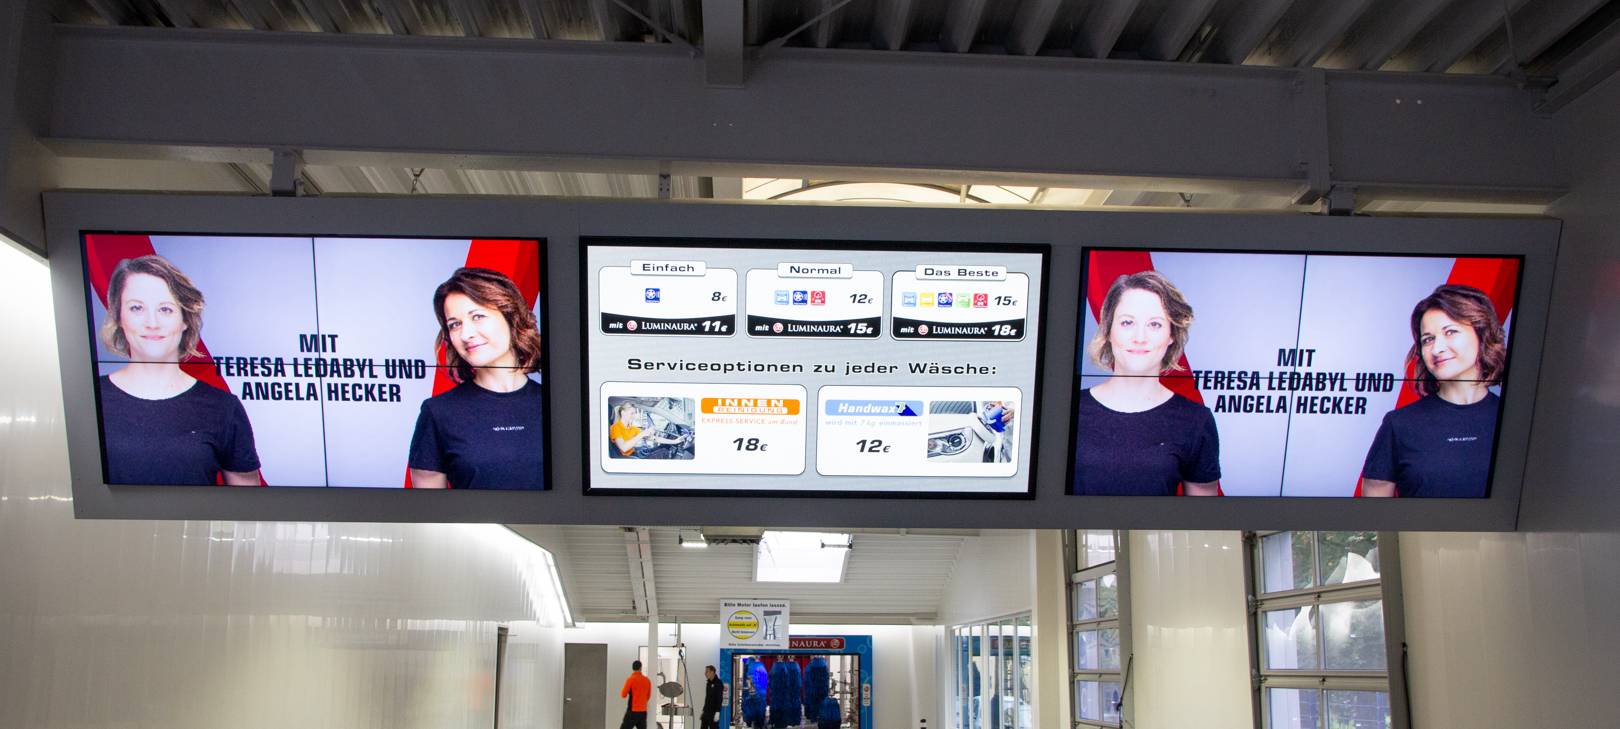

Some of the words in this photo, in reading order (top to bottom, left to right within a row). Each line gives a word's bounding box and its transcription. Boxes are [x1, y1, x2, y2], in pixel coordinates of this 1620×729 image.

[642, 263, 695, 273] Einfach
[790, 266, 841, 274] Normal
[924, 268, 951, 276] Das
[958, 268, 999, 277] Beste
[299, 334, 338, 352] MIT
[628, 358, 804, 374] Serviceoptionen
[813, 364, 835, 373] zu
[845, 362, 898, 375] jeder
[908, 362, 998, 375] Wäsche:
[1277, 348, 1316, 367] MIT
[214, 356, 286, 378] TERESA
[293, 357, 378, 379] LEDABYL
[385, 358, 426, 379] UND
[1193, 370, 1260, 391] TERESA
[1268, 371, 1348, 392] LEDABYL
[1355, 372, 1395, 393] UND
[241, 381, 319, 401] ANGELA
[327, 382, 402, 402] HECKER
[717, 398, 784, 407] INNEN
[1214, 395, 1288, 414] ANGELA
[1296, 396, 1368, 415] HECKER
